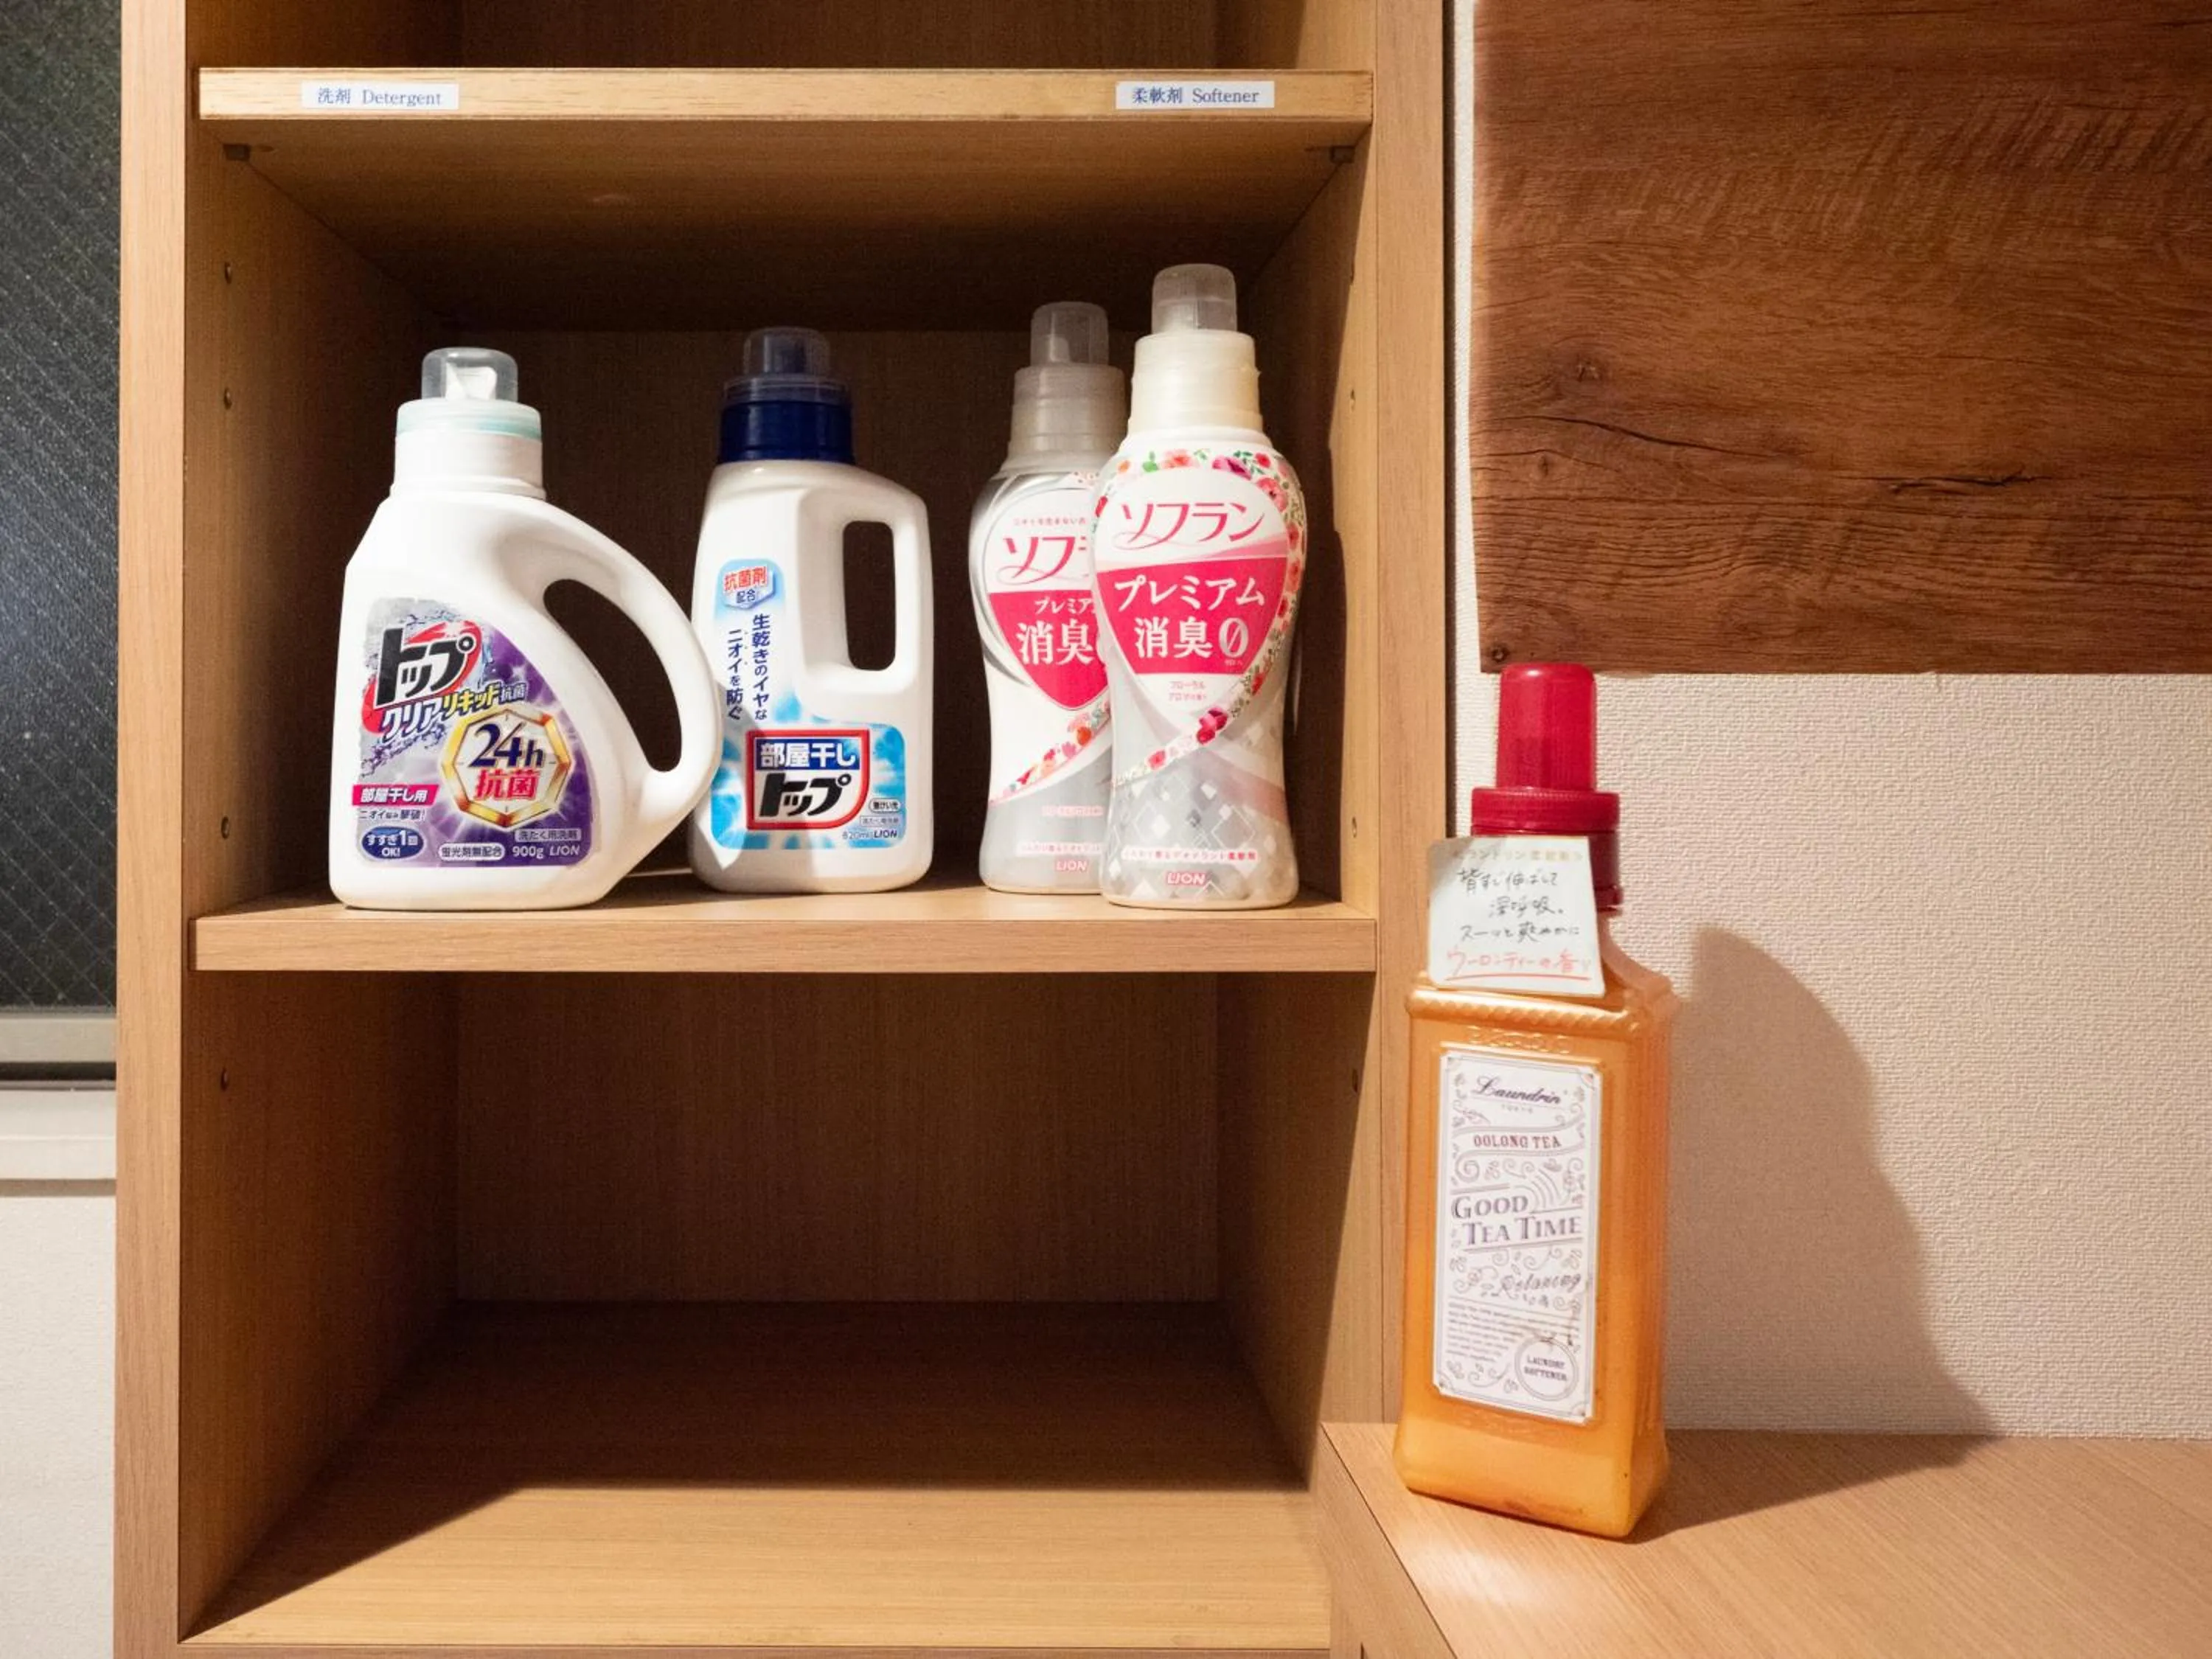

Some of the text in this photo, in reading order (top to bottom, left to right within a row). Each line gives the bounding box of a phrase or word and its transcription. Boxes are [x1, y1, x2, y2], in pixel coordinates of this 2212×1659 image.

[318, 87, 442, 107] 洗剤 Detergent
[1133, 86, 1260, 104] 柔軟剤 Softener
[1112, 502, 1265, 551] ソフラン
[723, 566, 768, 591] 抗菌剤
[736, 588, 757, 604] 配合
[1034, 596, 1096, 615] プレミア
[1114, 574, 1265, 612] プレミアム
[1016, 618, 1099, 666] 消臭
[1134, 616, 1249, 659] 消臭0
[375, 627, 474, 706] トップ
[726, 628, 744, 720] ニオイを防ぐ
[752, 613, 771, 721] 生乾きのイヤな
[468, 722, 544, 768] 24h
[759, 742, 857, 769] 部屋干し
[360, 787, 428, 803] 部屋干し用
[473, 769, 540, 800] 抗菌
[759, 771, 852, 817] トップ
[366, 830, 419, 846] すすぎ1回
[874, 829, 897, 838] LION
[512, 844, 580, 859] 900g LION
[1056, 860, 1088, 872] LION
[1166, 872, 1207, 886] LION
[1473, 1134, 1562, 1149] OOLONG TEA
[1451, 1195, 1528, 1220] GOOD
[1462, 1216, 1582, 1245] TEA TIME
[1526, 1354, 1565, 1368] LAUNDRY
[1523, 1367, 1568, 1382] SOFTENER
